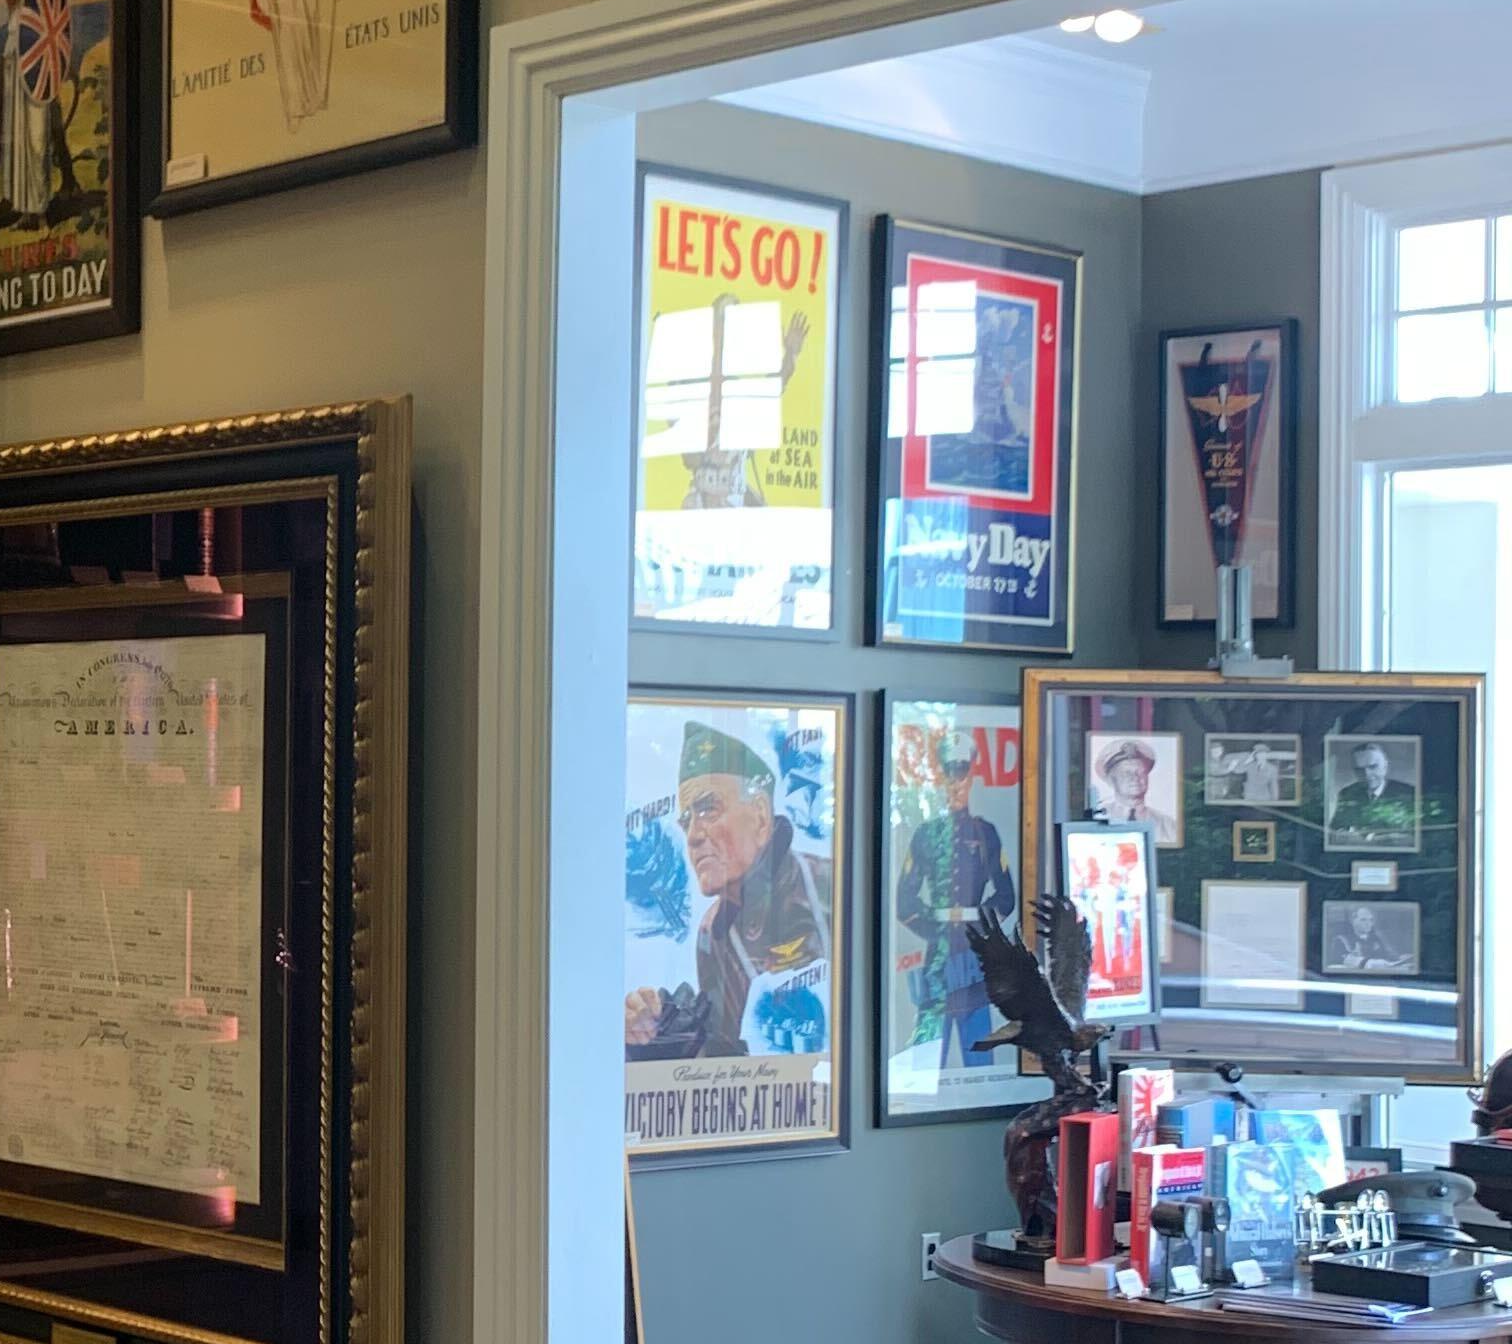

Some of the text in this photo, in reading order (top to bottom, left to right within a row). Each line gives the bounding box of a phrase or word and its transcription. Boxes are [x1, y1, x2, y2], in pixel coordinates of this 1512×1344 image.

[399, 2, 440, 34] UNIS
[240, 53, 265, 79] DES
[658, 207, 742, 280] LET'S
[782, 426, 818, 447] LAND
[785, 448, 812, 468] SEA
[793, 470, 818, 490] AIR
[988, 523, 1051, 578] Day
[691, 1085, 748, 1135] BEGINS
[750, 1084, 769, 1130] AT
